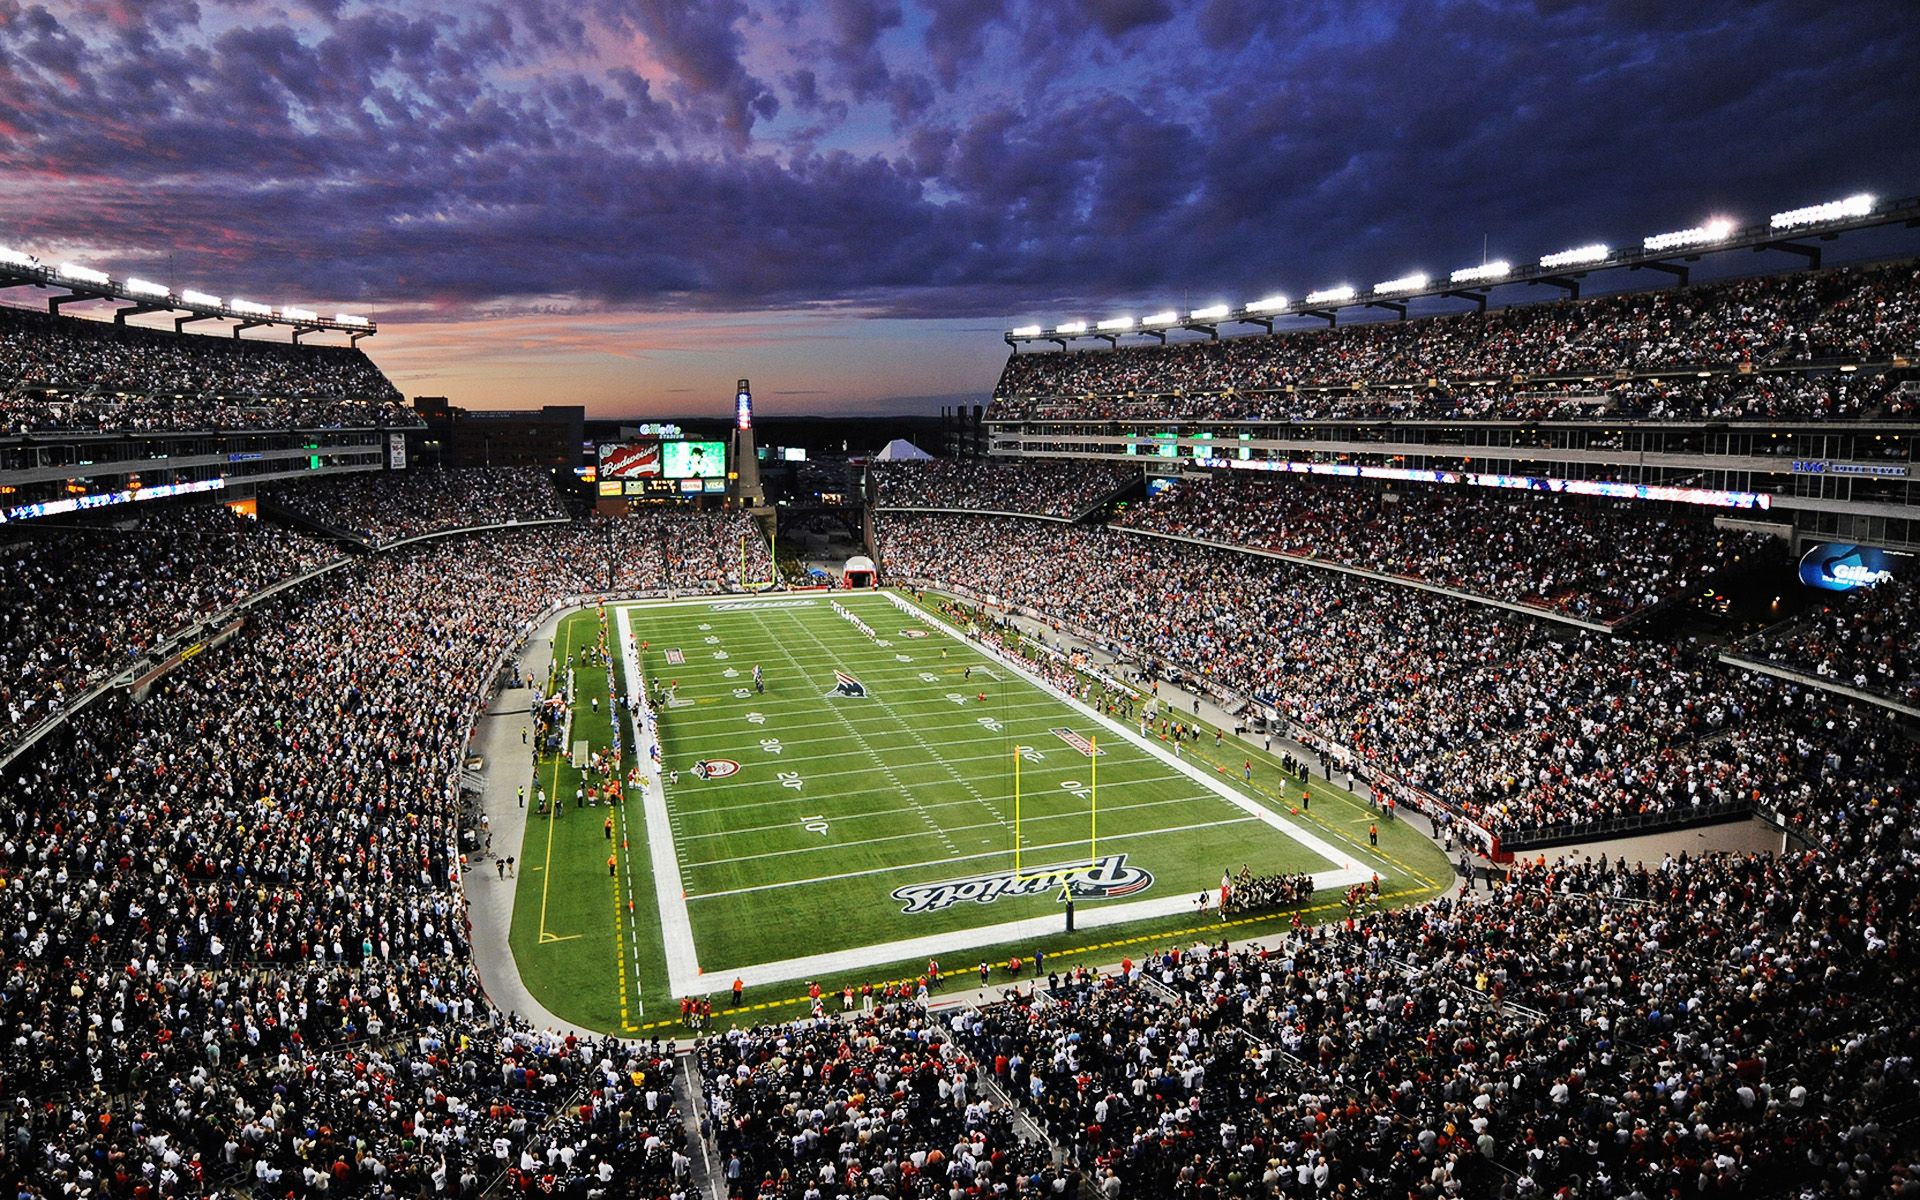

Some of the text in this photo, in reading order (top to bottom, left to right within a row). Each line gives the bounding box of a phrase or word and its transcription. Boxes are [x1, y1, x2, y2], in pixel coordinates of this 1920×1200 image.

[640, 424, 681, 435] Gillette
[600, 444, 659, 477] Budweiser
[705, 481, 725, 489] VISA
[759, 738, 783, 753] 30
[776, 771, 803, 788] 20
[1060, 780, 1092, 798] 10
[800, 814, 829, 832] 10
[891, 852, 1155, 914] Patriots
